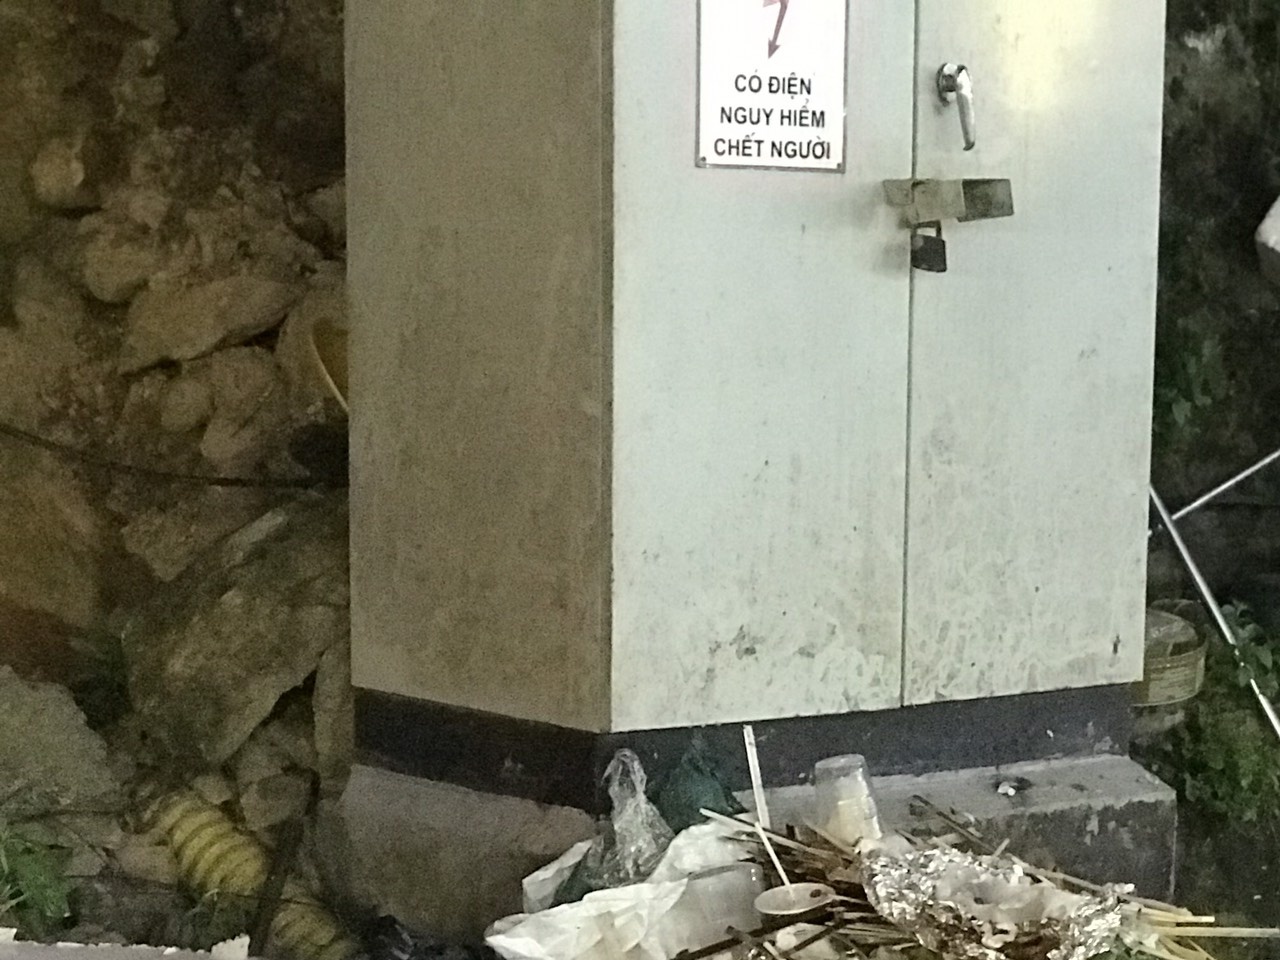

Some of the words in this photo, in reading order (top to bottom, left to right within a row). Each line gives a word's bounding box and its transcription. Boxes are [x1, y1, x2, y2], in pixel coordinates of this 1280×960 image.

[768, 72, 811, 99] ĐIỆN
[720, 106, 774, 126] NGUY
[780, 98, 825, 128] HIỂM
[714, 132, 764, 157] CHẾT
[771, 136, 831, 159] NGƯỜI
